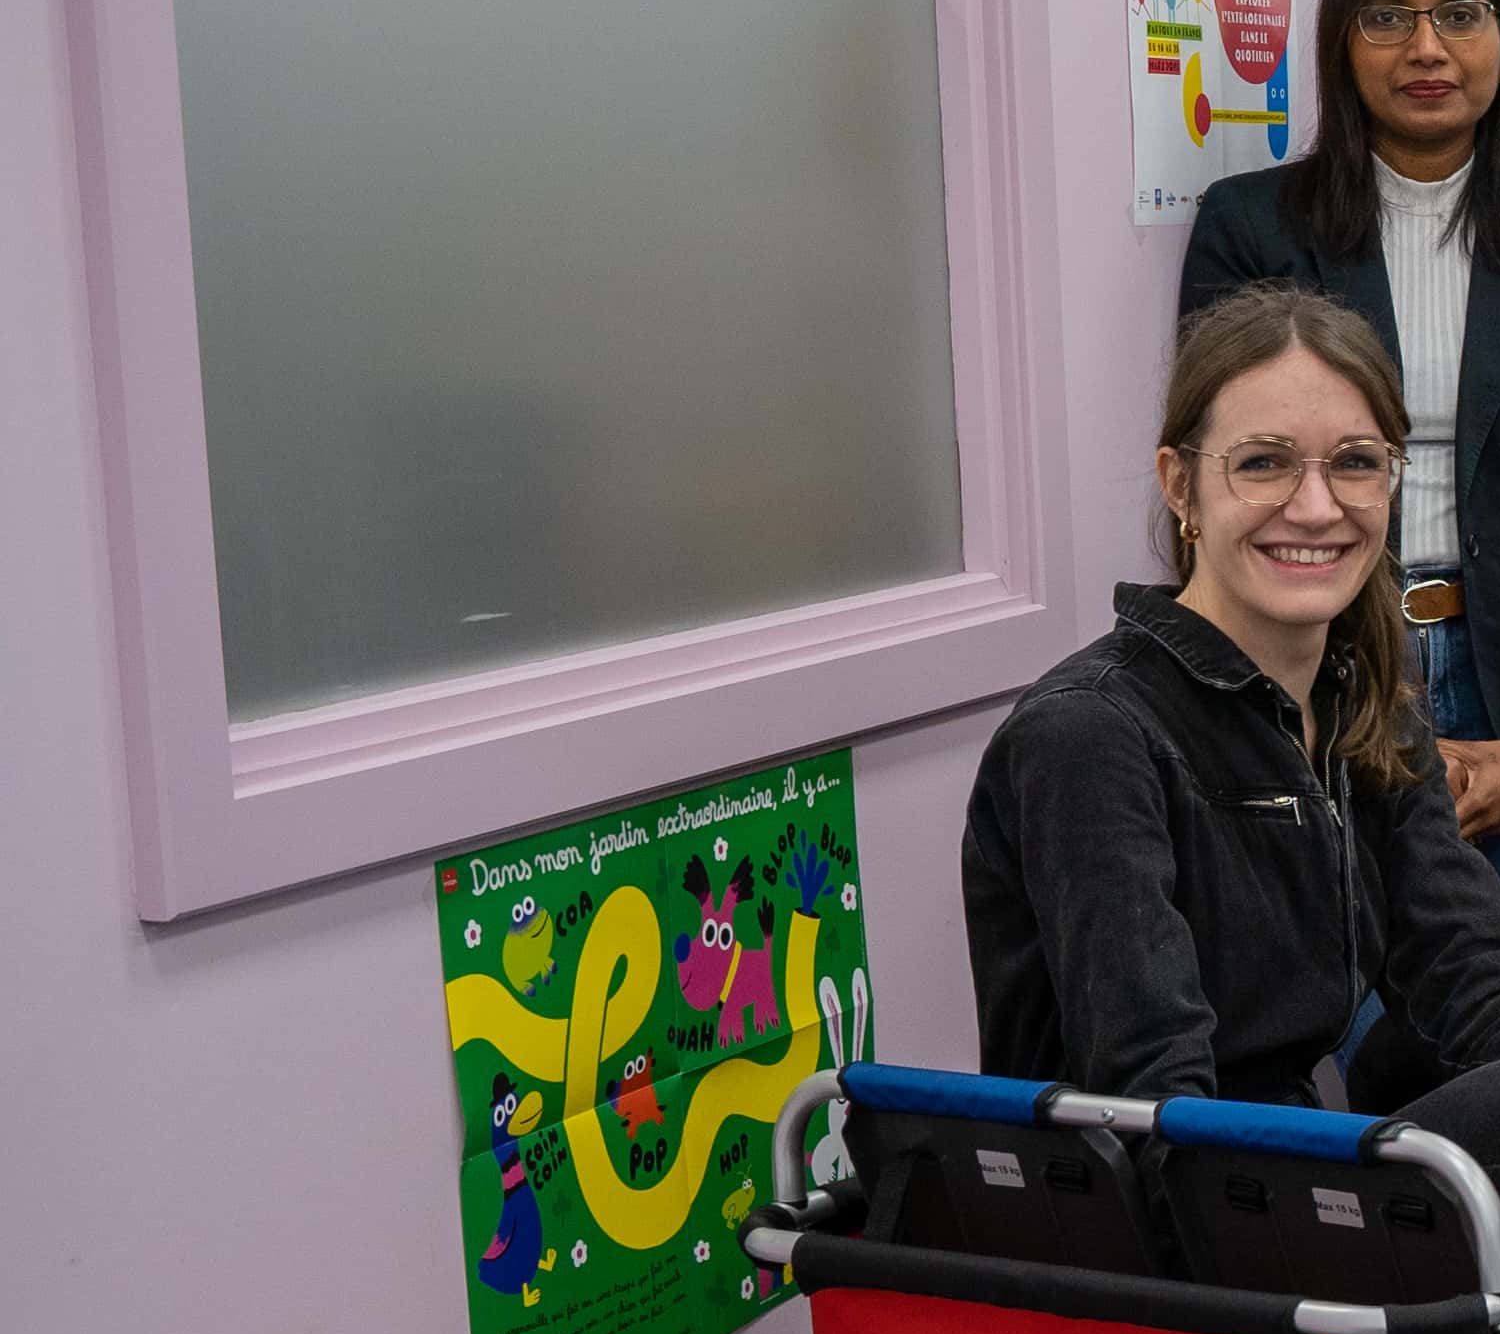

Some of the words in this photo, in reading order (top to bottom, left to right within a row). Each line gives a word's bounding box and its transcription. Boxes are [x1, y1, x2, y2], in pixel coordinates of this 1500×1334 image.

[1222, 10, 1286, 28] L'EXTRAORDINAIRE
[1240, 30, 1259, 44] DANS
[1260, 32, 1268, 44] LE
[1235, 48, 1274, 64] QUOTIDIEN
[470, 859, 532, 896] Dans
[535, 846, 584, 874] mon
[589, 820, 650, 876] jardin
[657, 786, 777, 838] extraordinaire,
[782, 767, 799, 803] il
[821, 823, 852, 870] BLOP
[763, 823, 795, 886] BLOP
[555, 891, 593, 937] COA
[667, 1022, 714, 1052] OUAH
[719, 1133, 748, 1176] HOP
